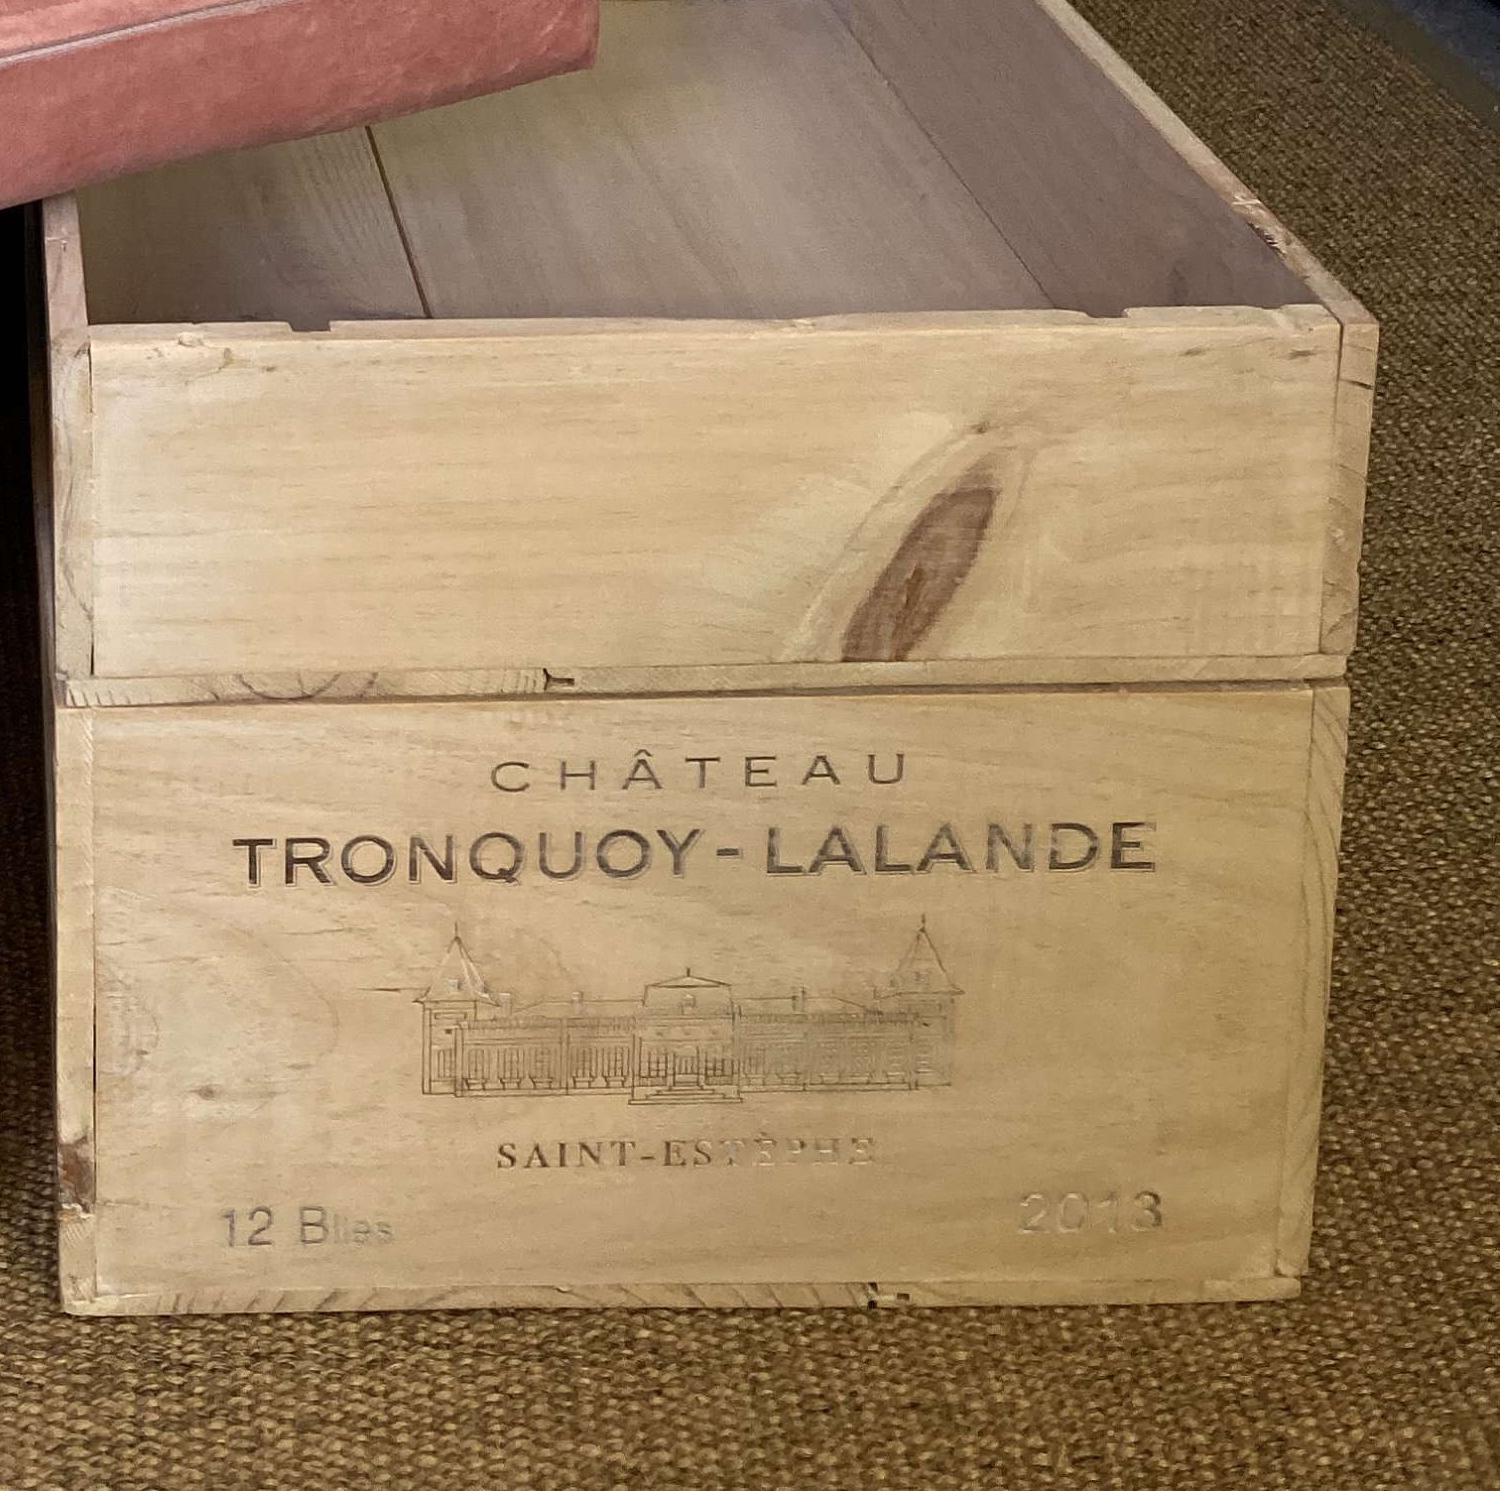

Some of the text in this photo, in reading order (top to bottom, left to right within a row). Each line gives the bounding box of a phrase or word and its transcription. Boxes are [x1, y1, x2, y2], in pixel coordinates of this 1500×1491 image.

[491, 748, 905, 792] CHÂTEAU
[232, 821, 1157, 887] TRONQUOY-LALANDE
[222, 1207, 275, 1248] 12
[1018, 1190, 1164, 1235] 2013
